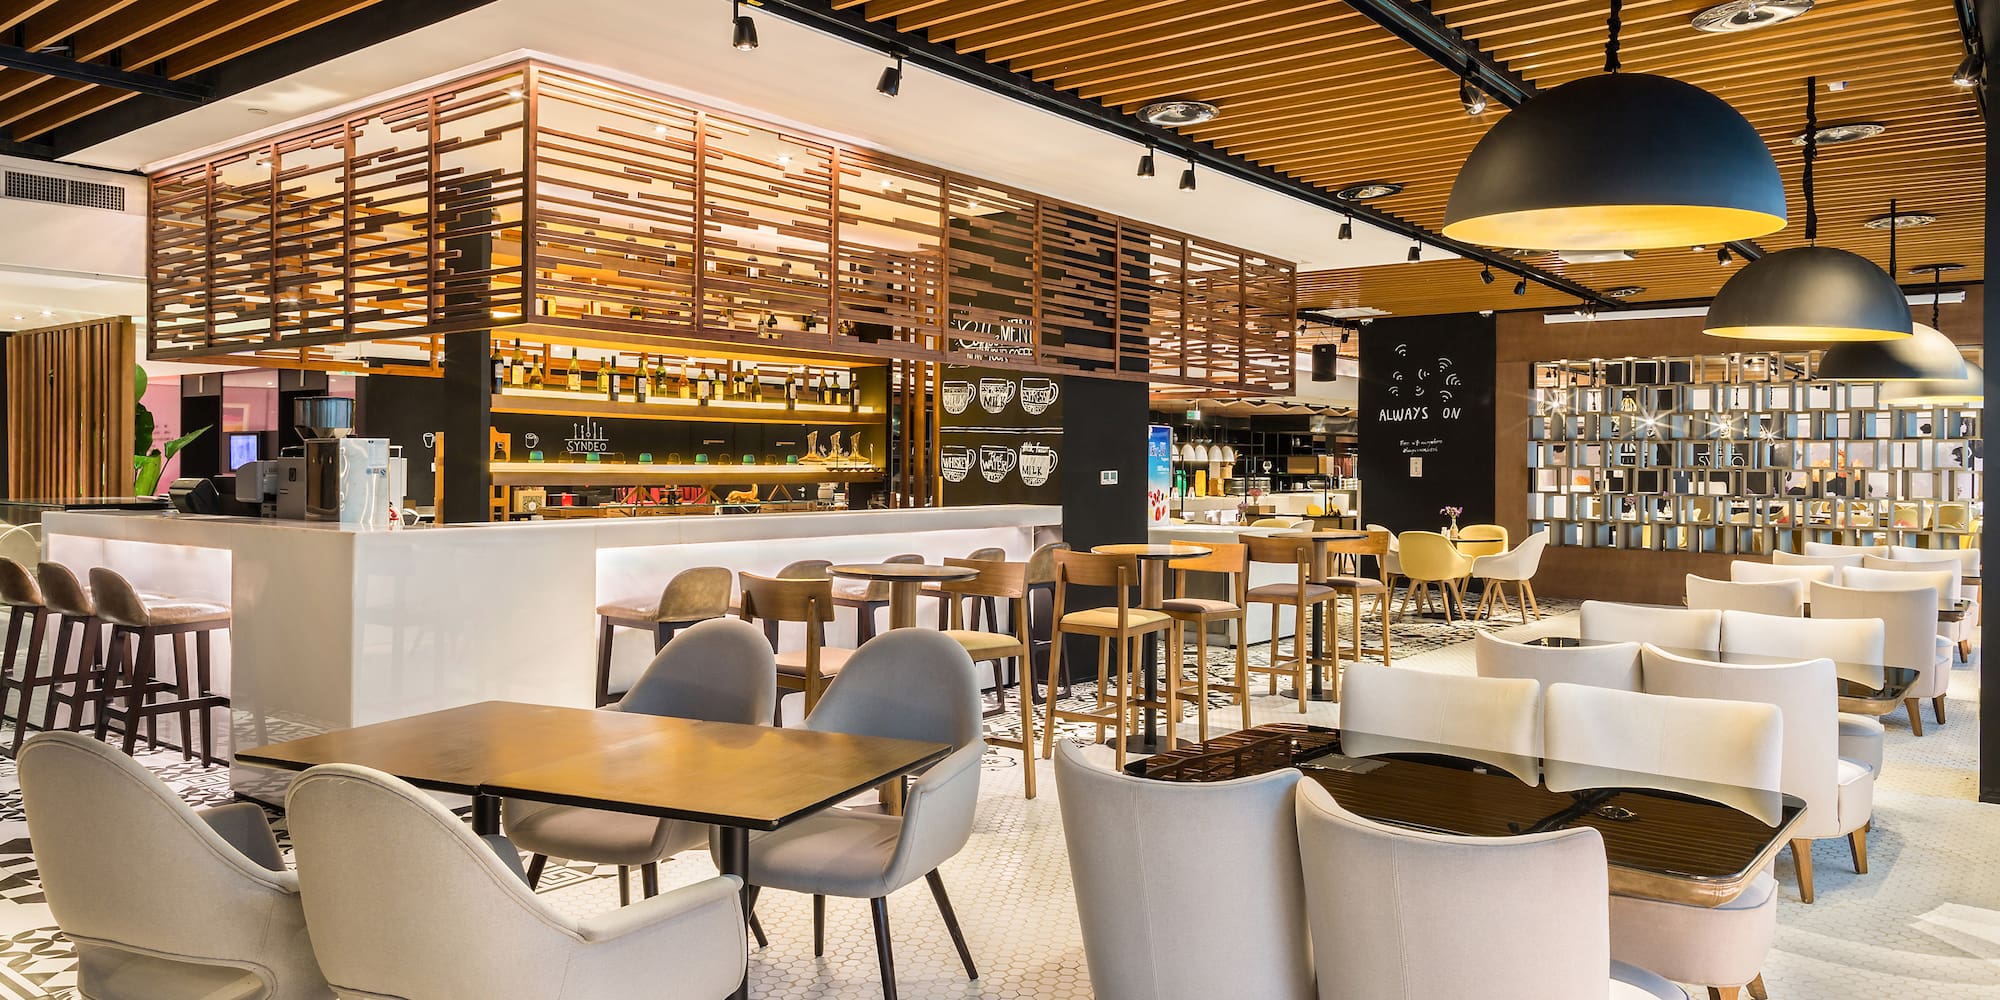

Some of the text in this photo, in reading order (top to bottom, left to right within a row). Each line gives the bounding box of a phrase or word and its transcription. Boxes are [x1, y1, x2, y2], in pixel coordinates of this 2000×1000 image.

[1379, 406, 1461, 421] ALWAYS ON
[566, 440, 607, 451] SYNDEO
[982, 459, 1007, 471] WATER
[1022, 465, 1042, 475] MILK
